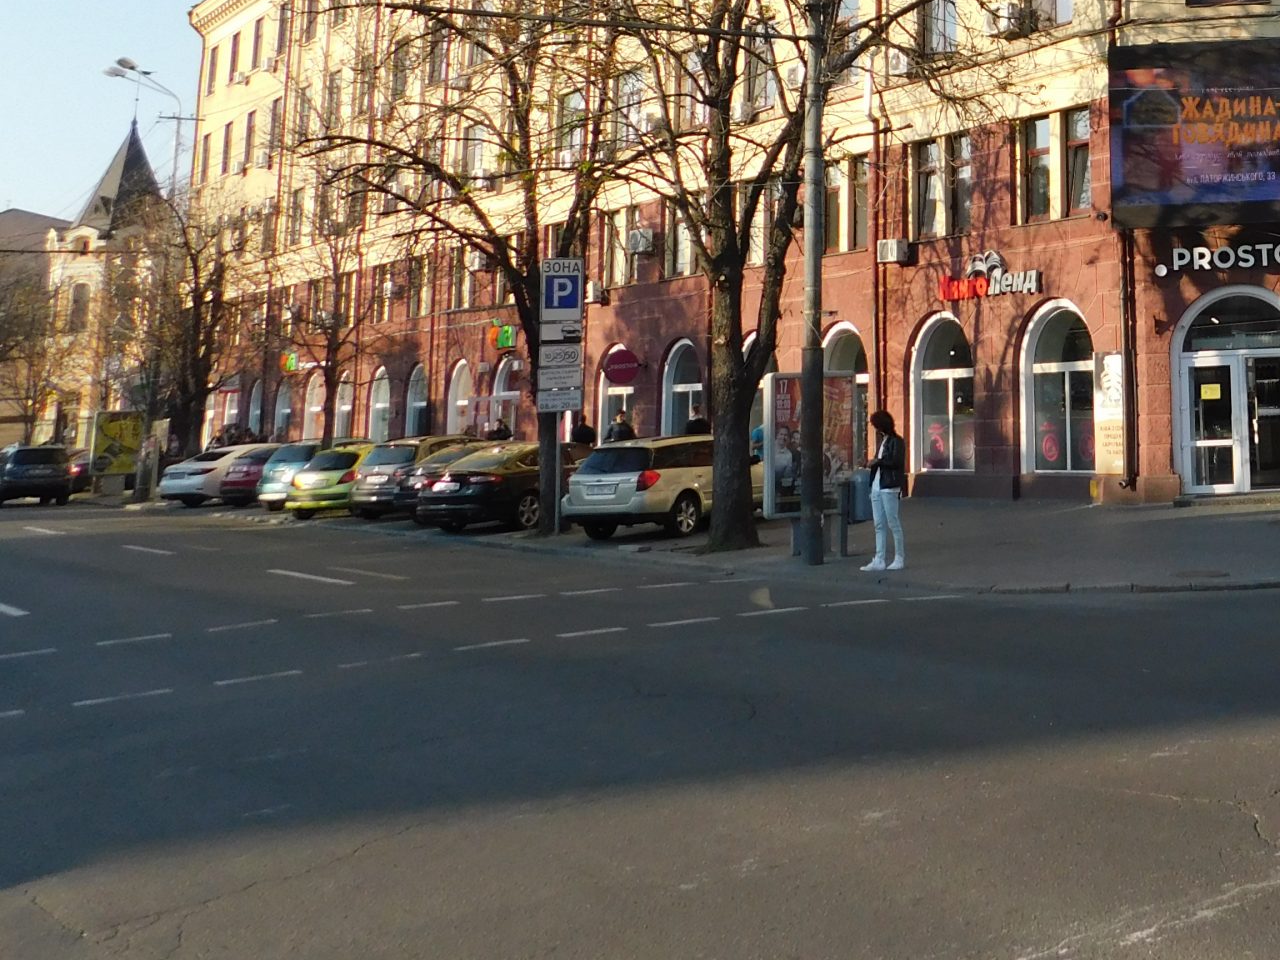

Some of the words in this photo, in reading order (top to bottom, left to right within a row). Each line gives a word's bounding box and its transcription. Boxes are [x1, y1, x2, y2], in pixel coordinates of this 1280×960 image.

[544, 262, 581, 273] ЗОНА
[553, 278, 573, 307] P
[780, 380, 788, 393] 17
